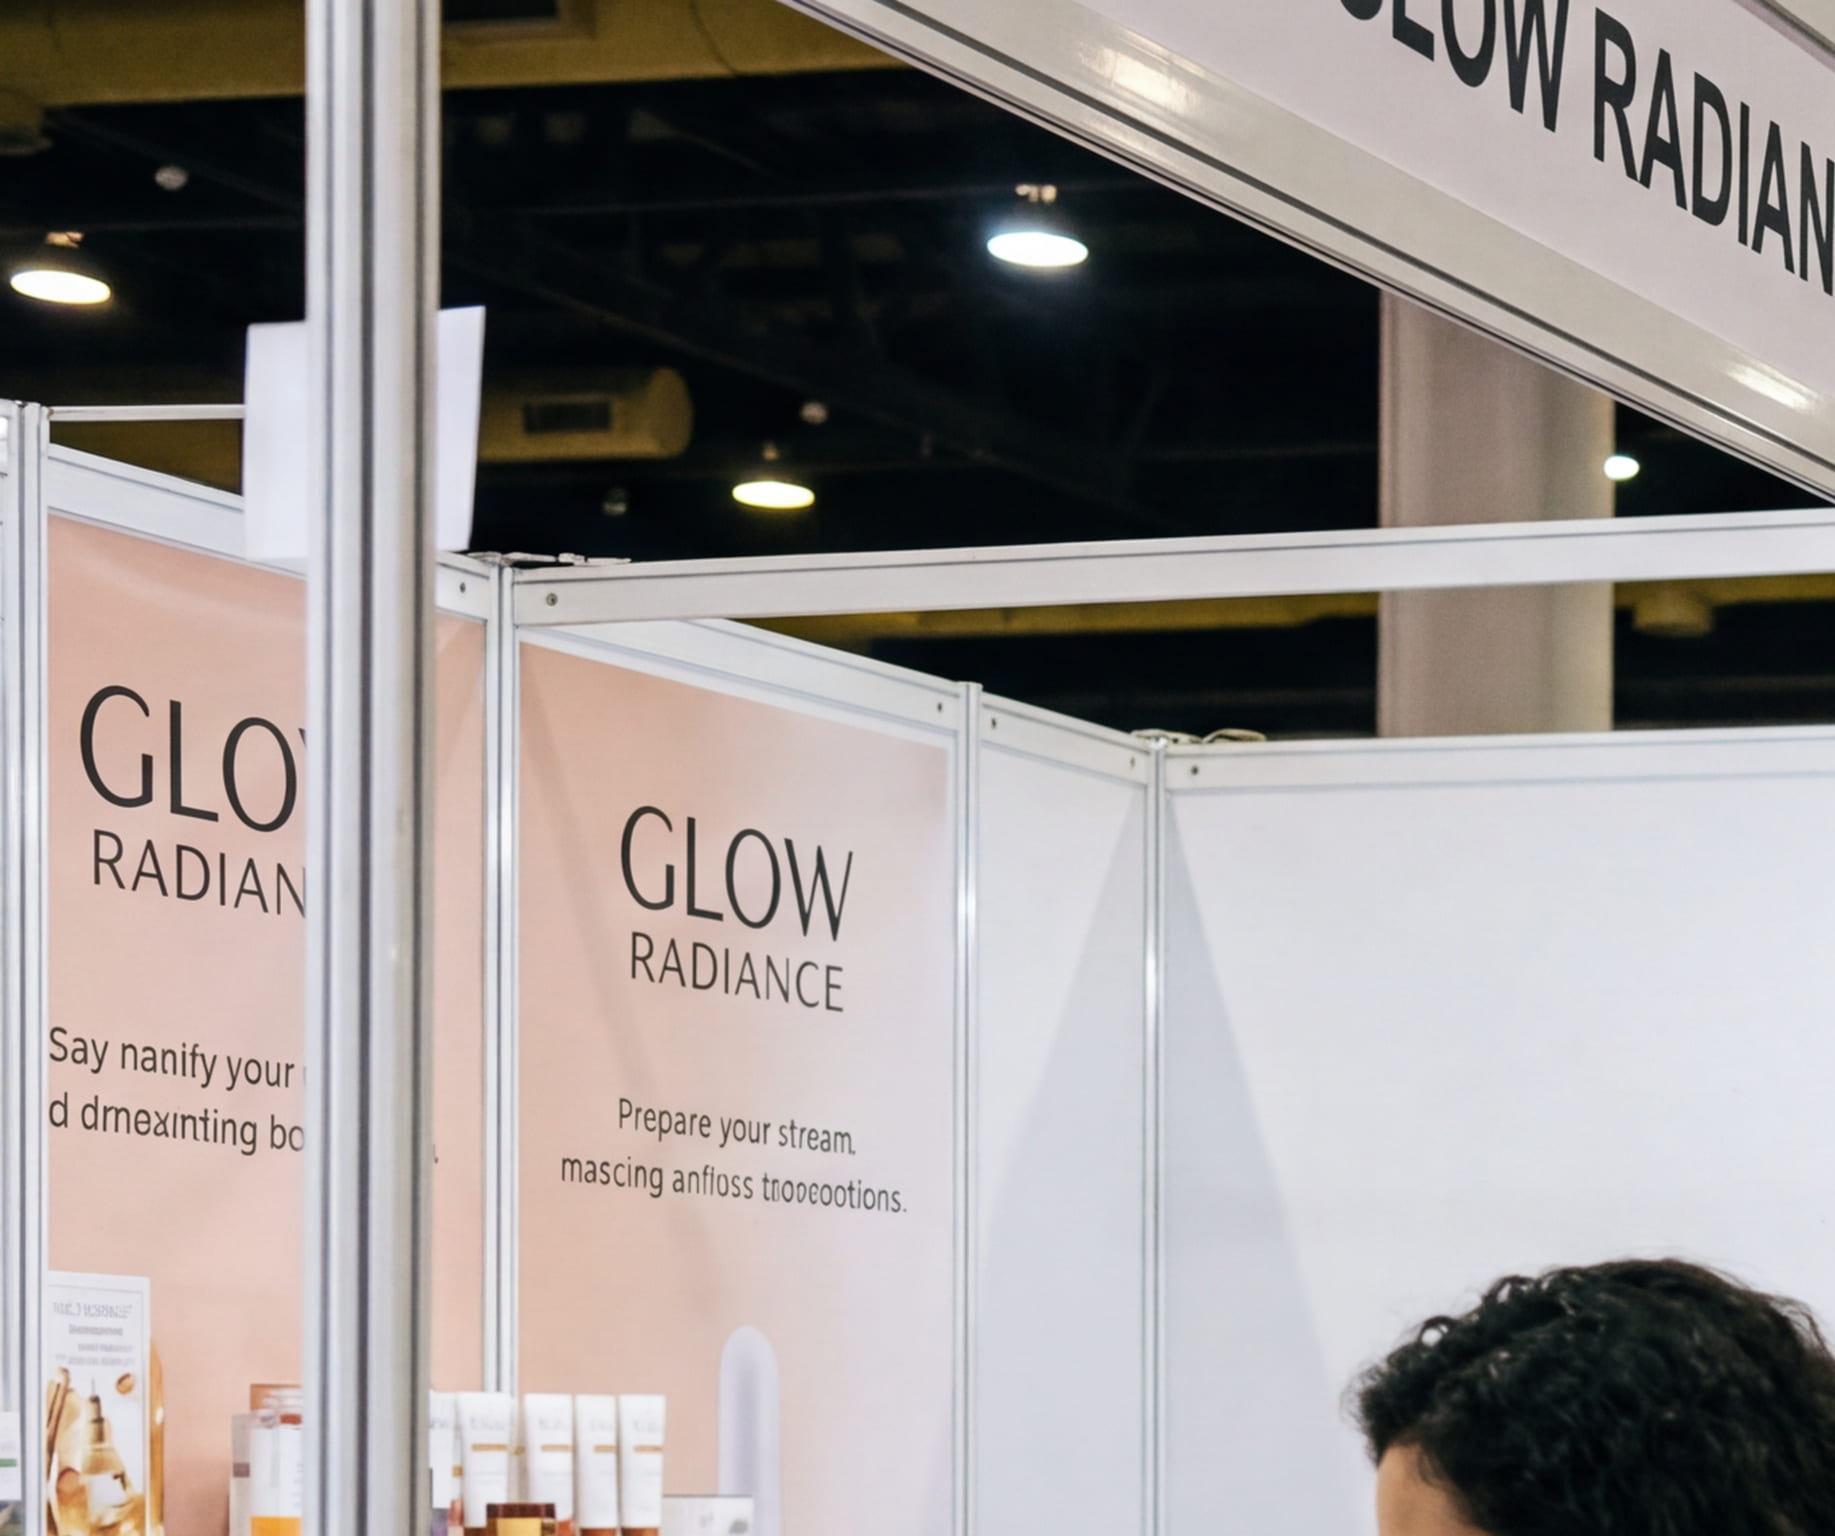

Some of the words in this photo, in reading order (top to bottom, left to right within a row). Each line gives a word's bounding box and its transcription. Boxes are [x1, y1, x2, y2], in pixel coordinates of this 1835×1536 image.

[79, 684, 306, 833] GLO
[620, 805, 854, 943] GLOW
[631, 930, 844, 1013] RADIANCE
[48, 1026, 109, 1074] Say
[120, 1041, 217, 1089] nanify
[225, 1053, 295, 1092] your
[618, 1097, 712, 1142] Prepare
[719, 1115, 772, 1149] your
[560, 1156, 663, 1199] mascing
